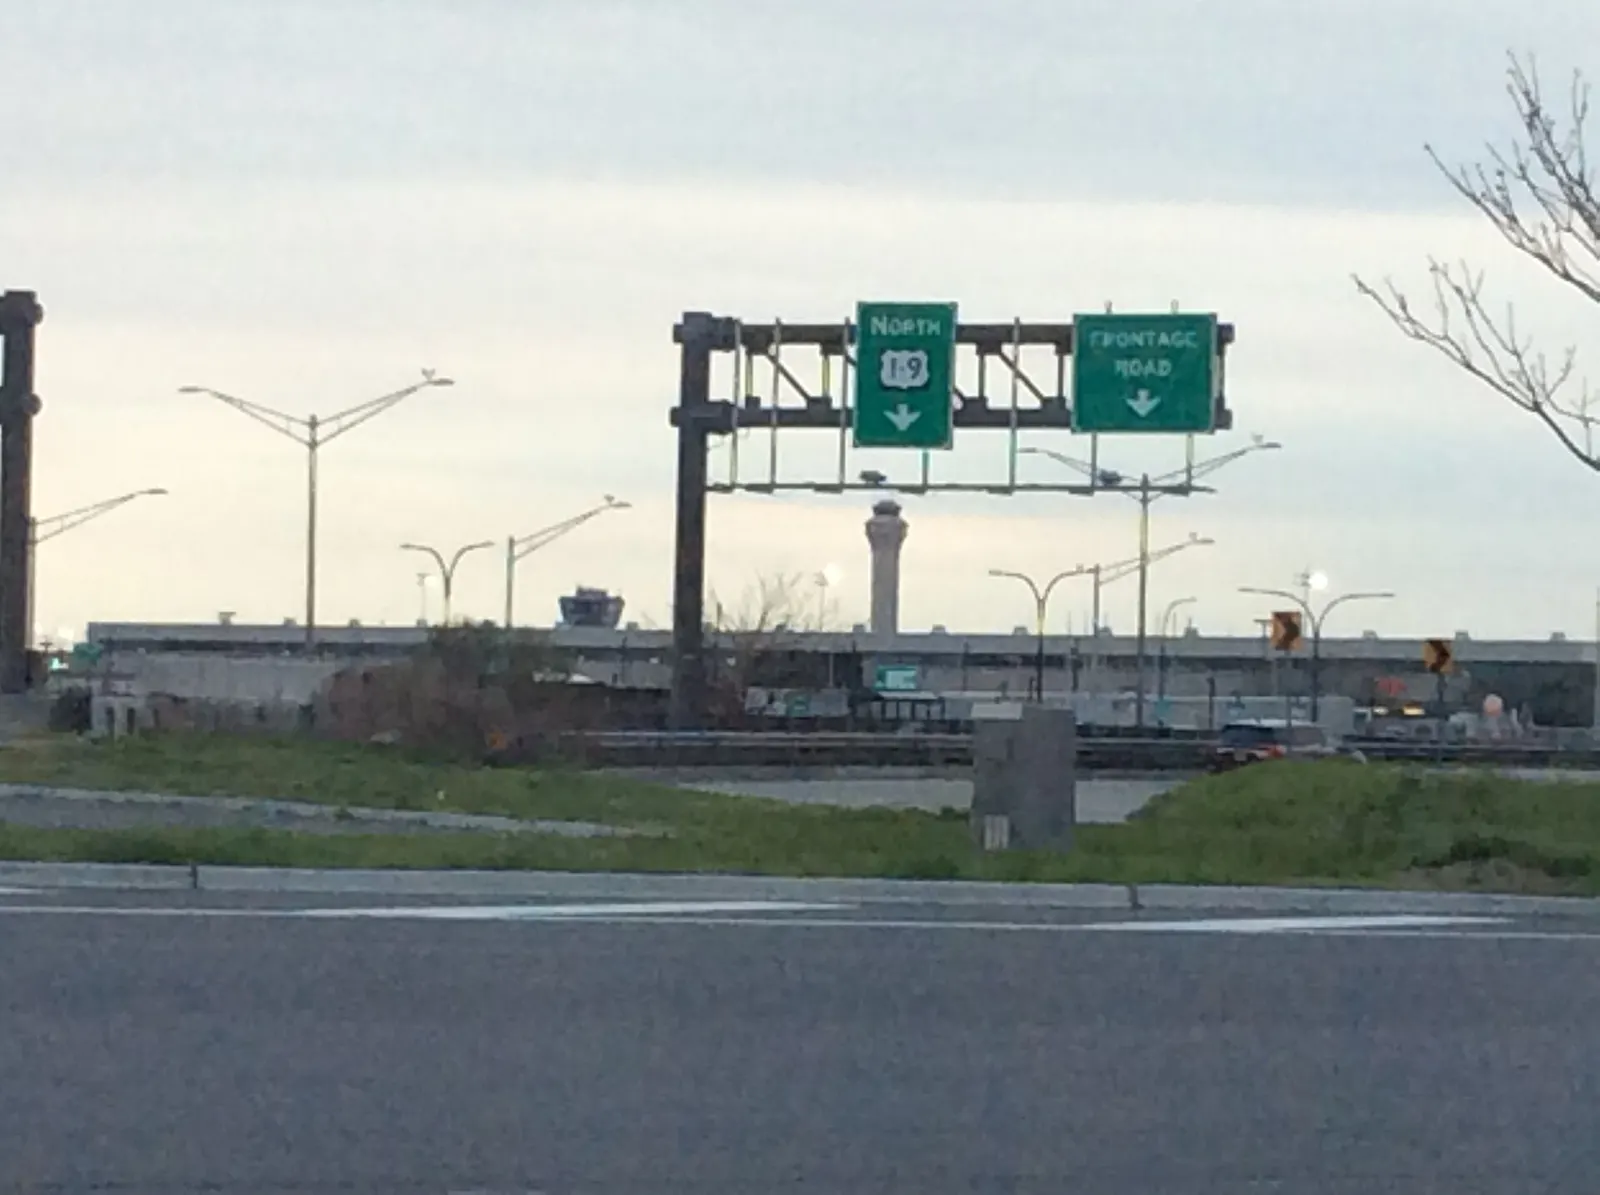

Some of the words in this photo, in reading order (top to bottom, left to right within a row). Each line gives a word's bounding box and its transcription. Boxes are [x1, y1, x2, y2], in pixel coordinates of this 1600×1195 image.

[870, 315, 941, 336] NORTH
[1089, 331, 1198, 349] FRONTAGE
[1113, 358, 1172, 378] ROAD
